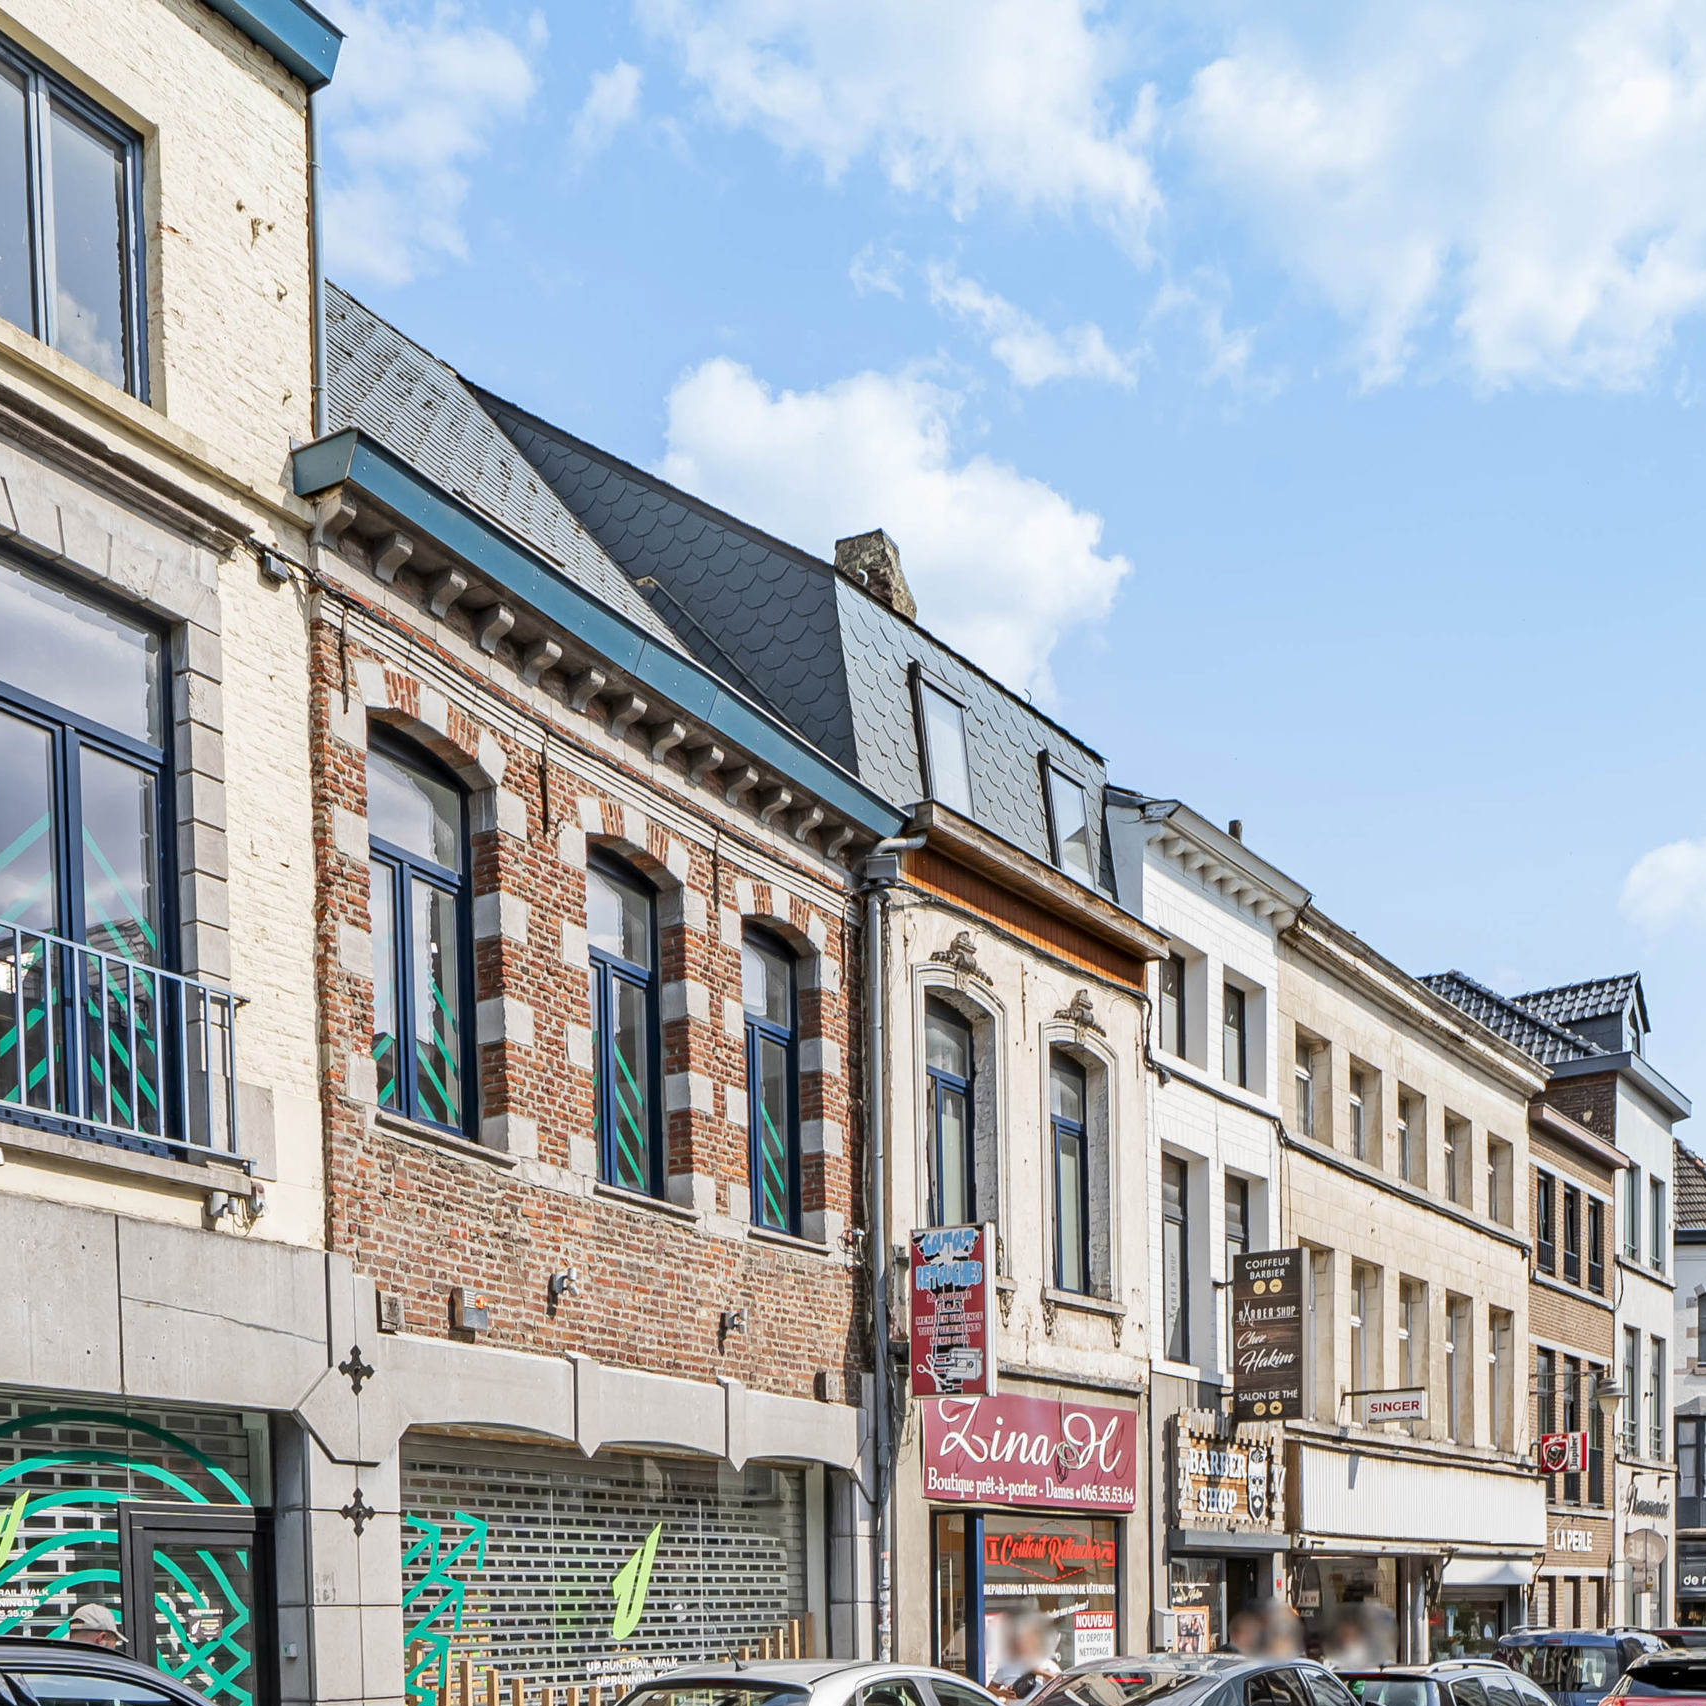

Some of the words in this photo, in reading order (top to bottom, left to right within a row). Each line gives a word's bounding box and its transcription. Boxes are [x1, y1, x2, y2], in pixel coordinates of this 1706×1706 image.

[1245, 1257, 1291, 1270] COIFFEUR
[1249, 1268, 1286, 1280] BARBIER
[1276, 1305, 1297, 1318] SHOP
[1237, 1331, 1267, 1350] Chez
[1238, 1348, 1295, 1375] Hakim
[1238, 1391, 1267, 1402] SALON
[1268, 1390, 1281, 1401] DE
[1282, 1387, 1299, 1399] THÉ
[1370, 1400, 1420, 1413] SINGER
[937, 1396, 1058, 1467] Zina
[1189, 1447, 1247, 1479] BARBER
[927, 1466, 974, 1496] Boutique
[976, 1473, 1038, 1502] prêt-à-porter
[1045, 1476, 1075, 1501] Dames
[1080, 1483, 1134, 1504] 065.35.53.64
[1197, 1487, 1238, 1514] SHOP
[1553, 1530, 1566, 1551] LA
[1567, 1530, 1593, 1552] PERLE
[1683, 1574, 1699, 1586] de
[1075, 1614, 1113, 1629] NOUVEAU
[1079, 1646, 1109, 1657] NETTOYAGE
